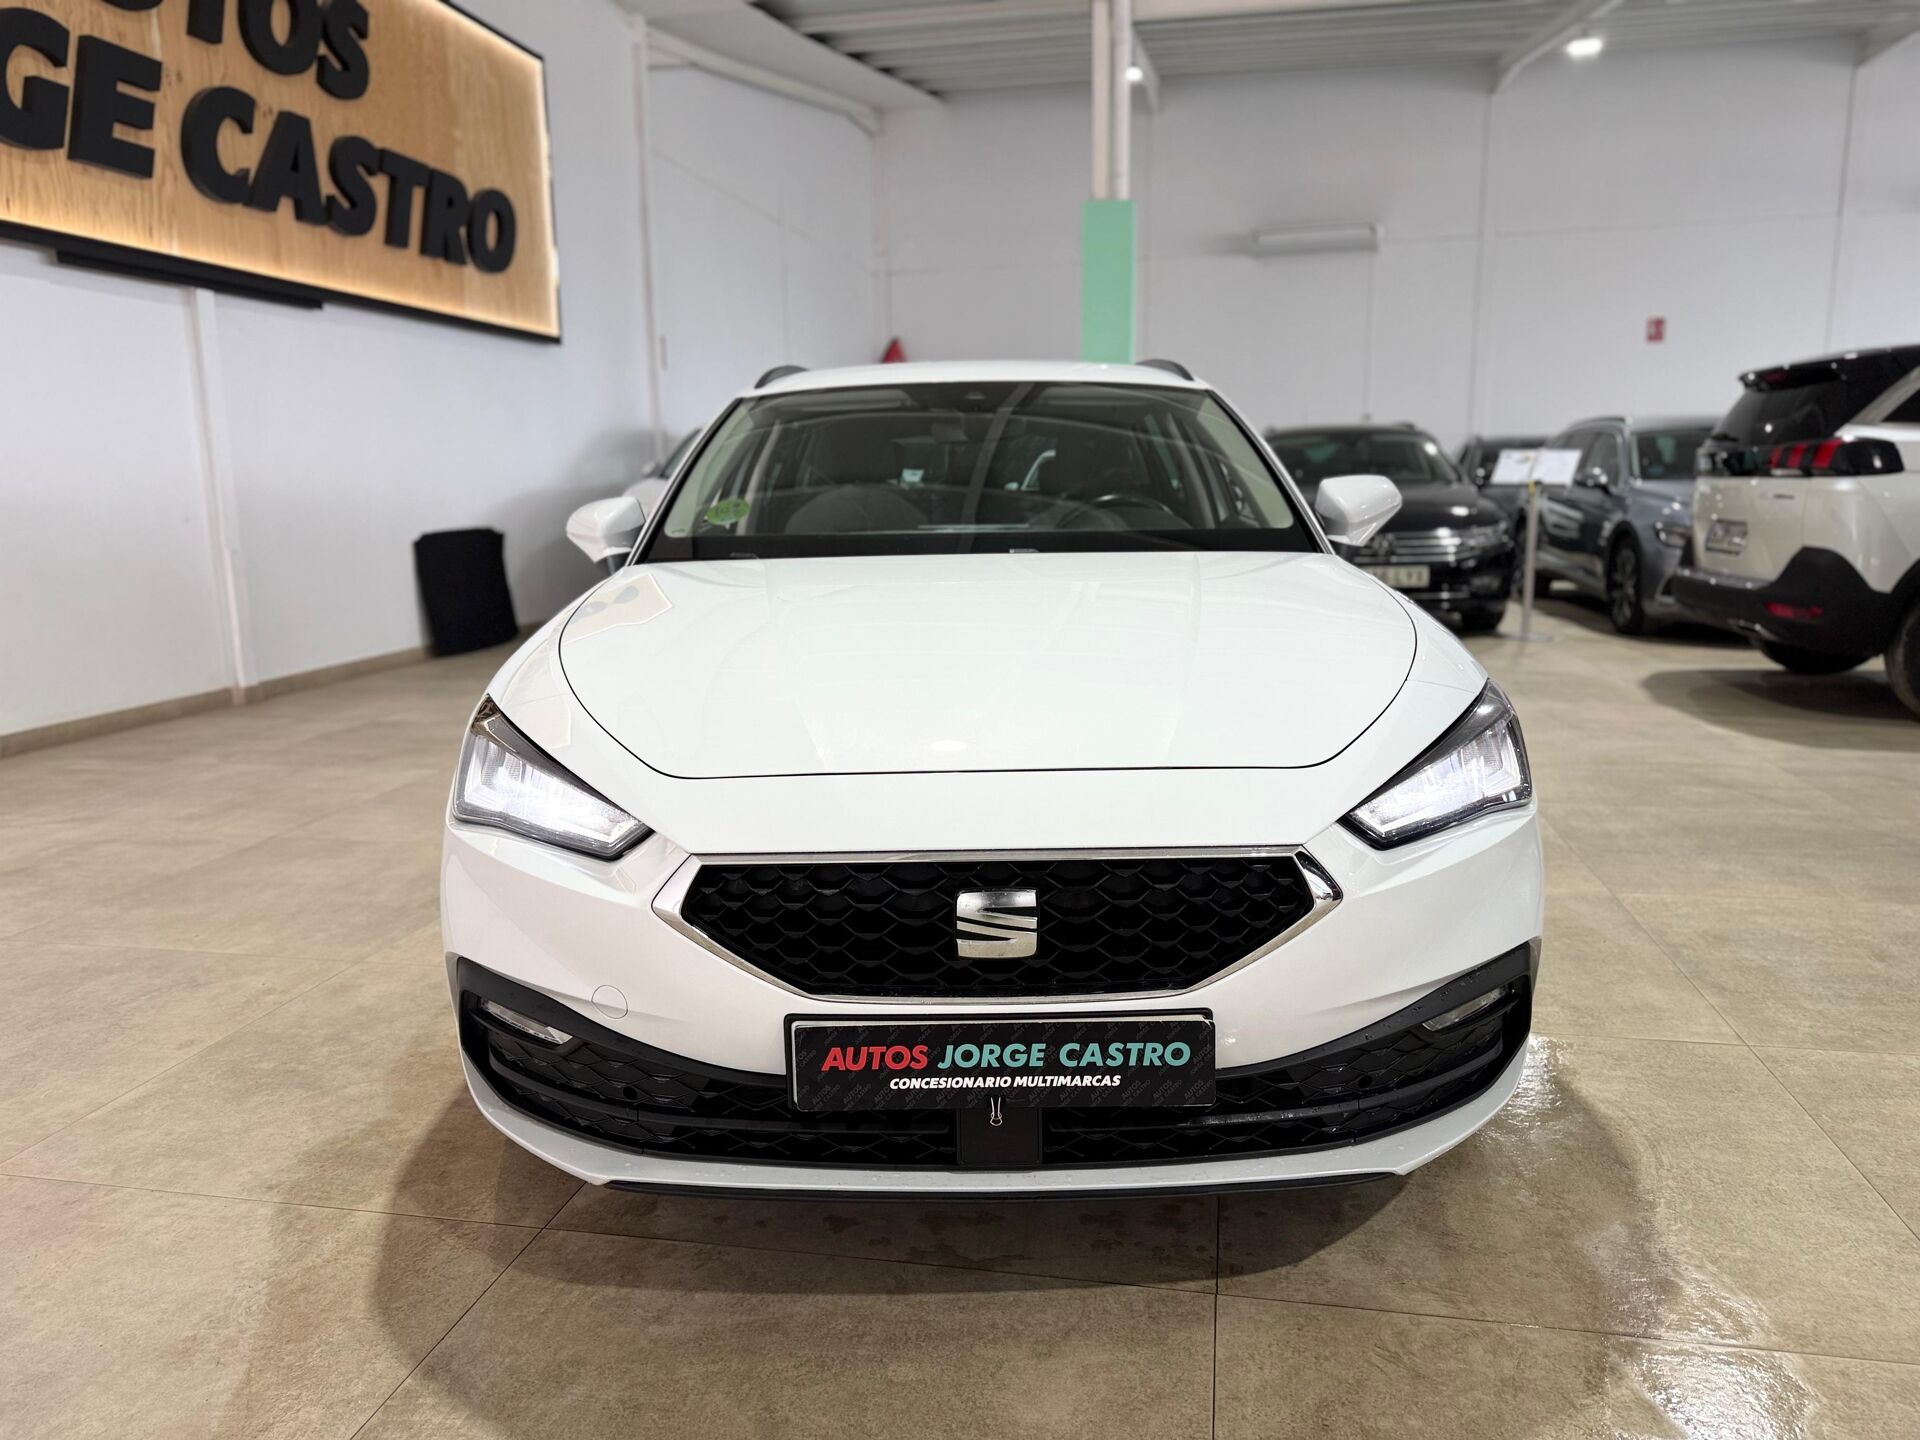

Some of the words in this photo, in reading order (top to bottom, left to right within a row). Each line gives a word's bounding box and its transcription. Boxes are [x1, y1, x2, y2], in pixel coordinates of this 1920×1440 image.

[181, 86, 516, 273] CASTRO
[821, 1045, 928, 1071] AUTOS
[937, 1043, 1046, 1070] JORGE
[1058, 1041, 1191, 1067] CASTRO
[889, 1076, 1012, 1090] CONCESIONARIO
[1013, 1075, 1121, 1087] MULTIMARCAS
